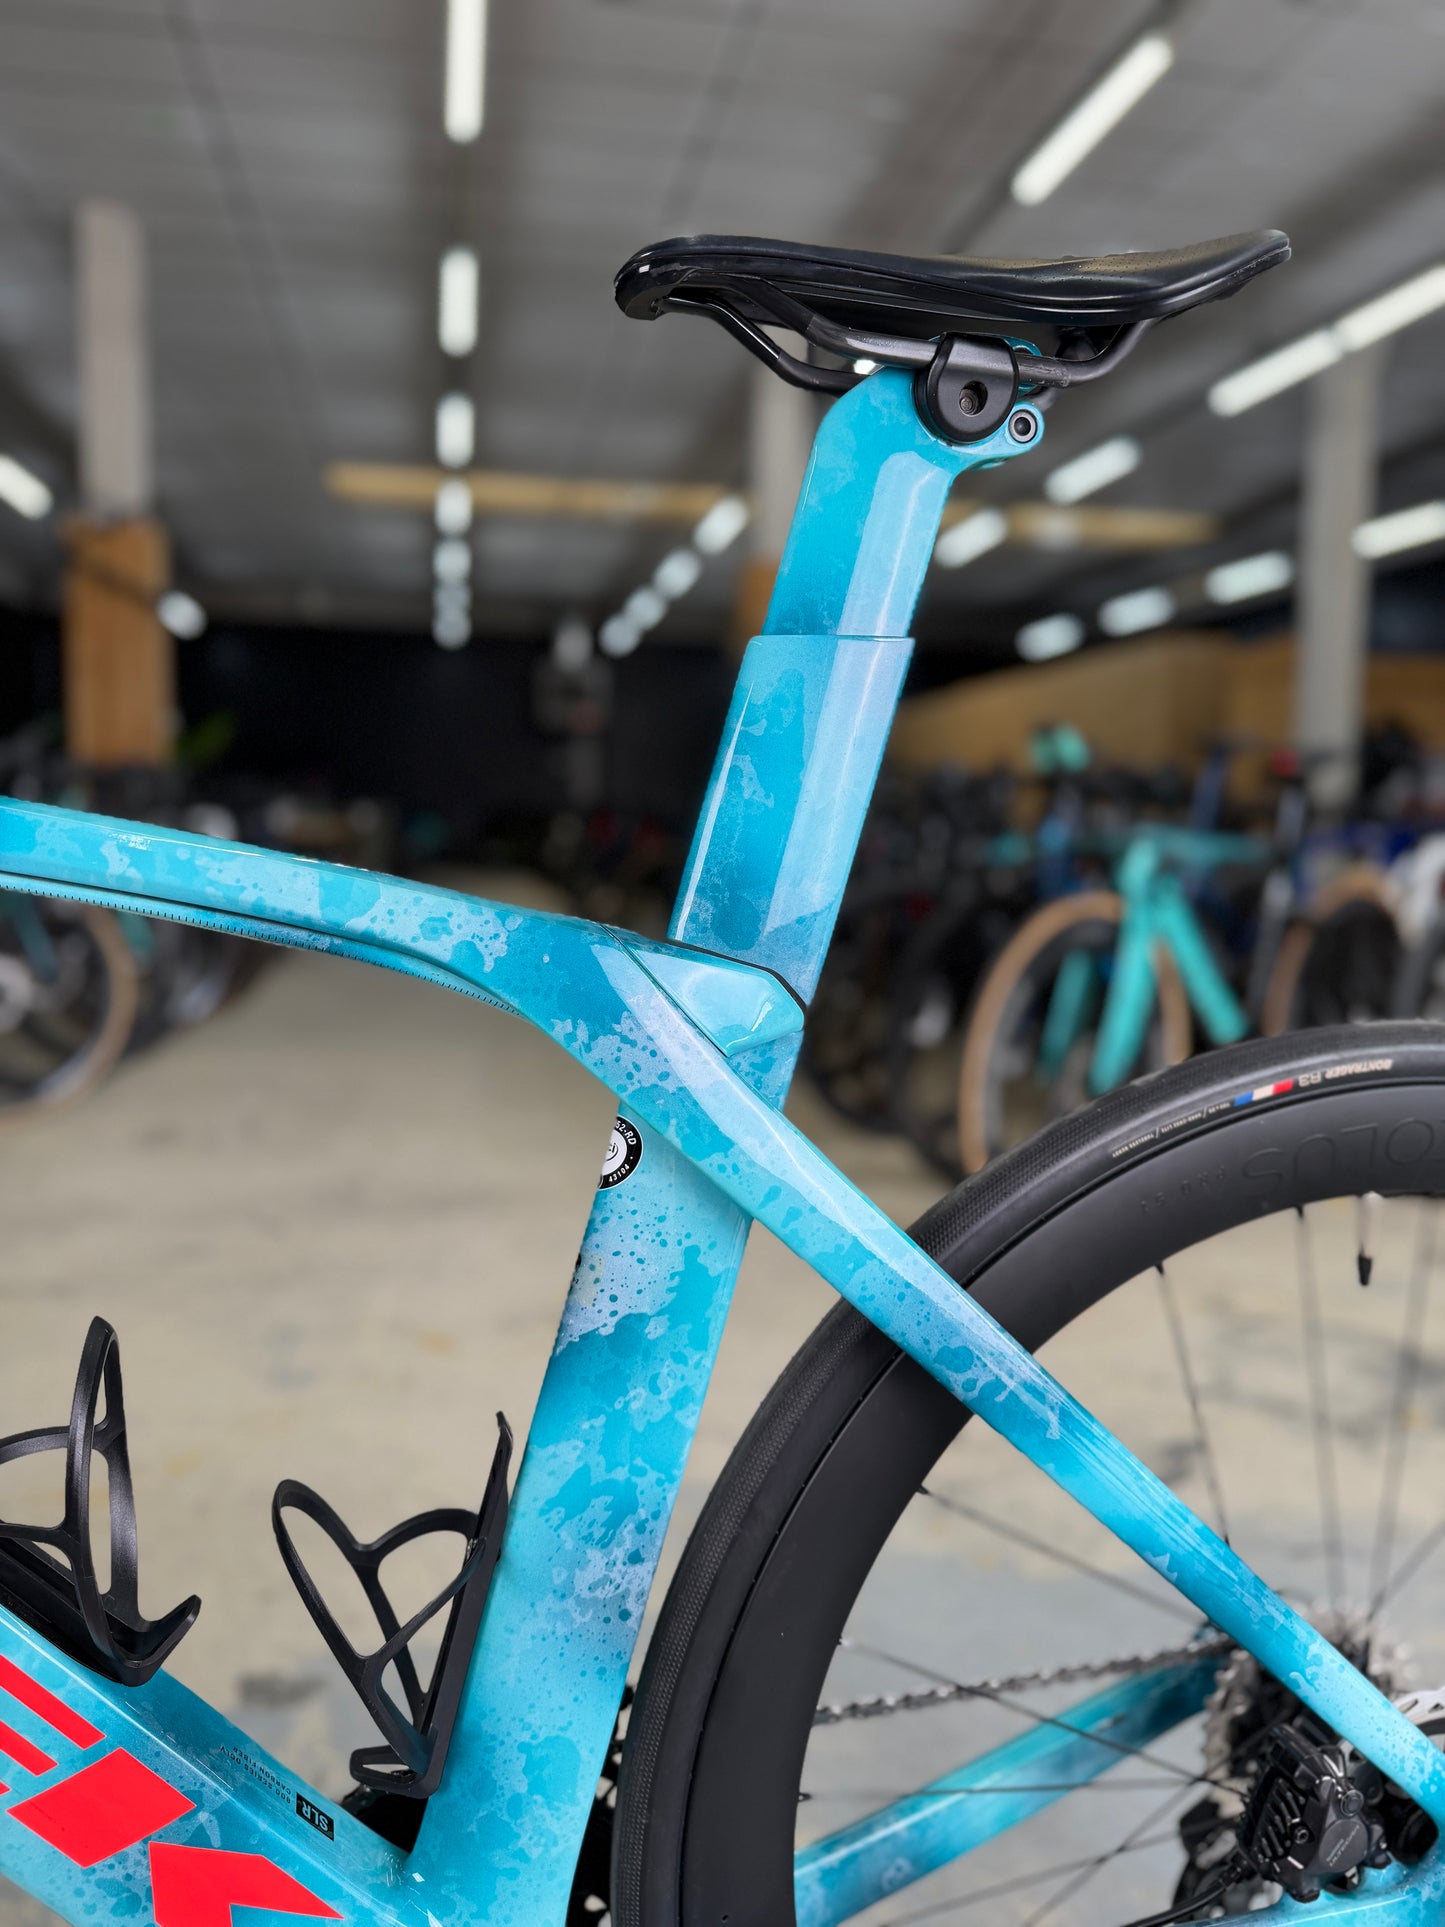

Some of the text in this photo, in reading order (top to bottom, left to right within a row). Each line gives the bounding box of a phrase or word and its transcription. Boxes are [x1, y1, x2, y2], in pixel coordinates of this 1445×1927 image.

[1298, 1071, 1321, 1087] R3
[1242, 1117, 1445, 1180] OLUS
[220, 1745, 241, 1765] OCLV
[233, 1746, 292, 1796] CARBON FIBER
[244, 1763, 273, 1790] SERIES
[302, 1801, 329, 1833] SLR
